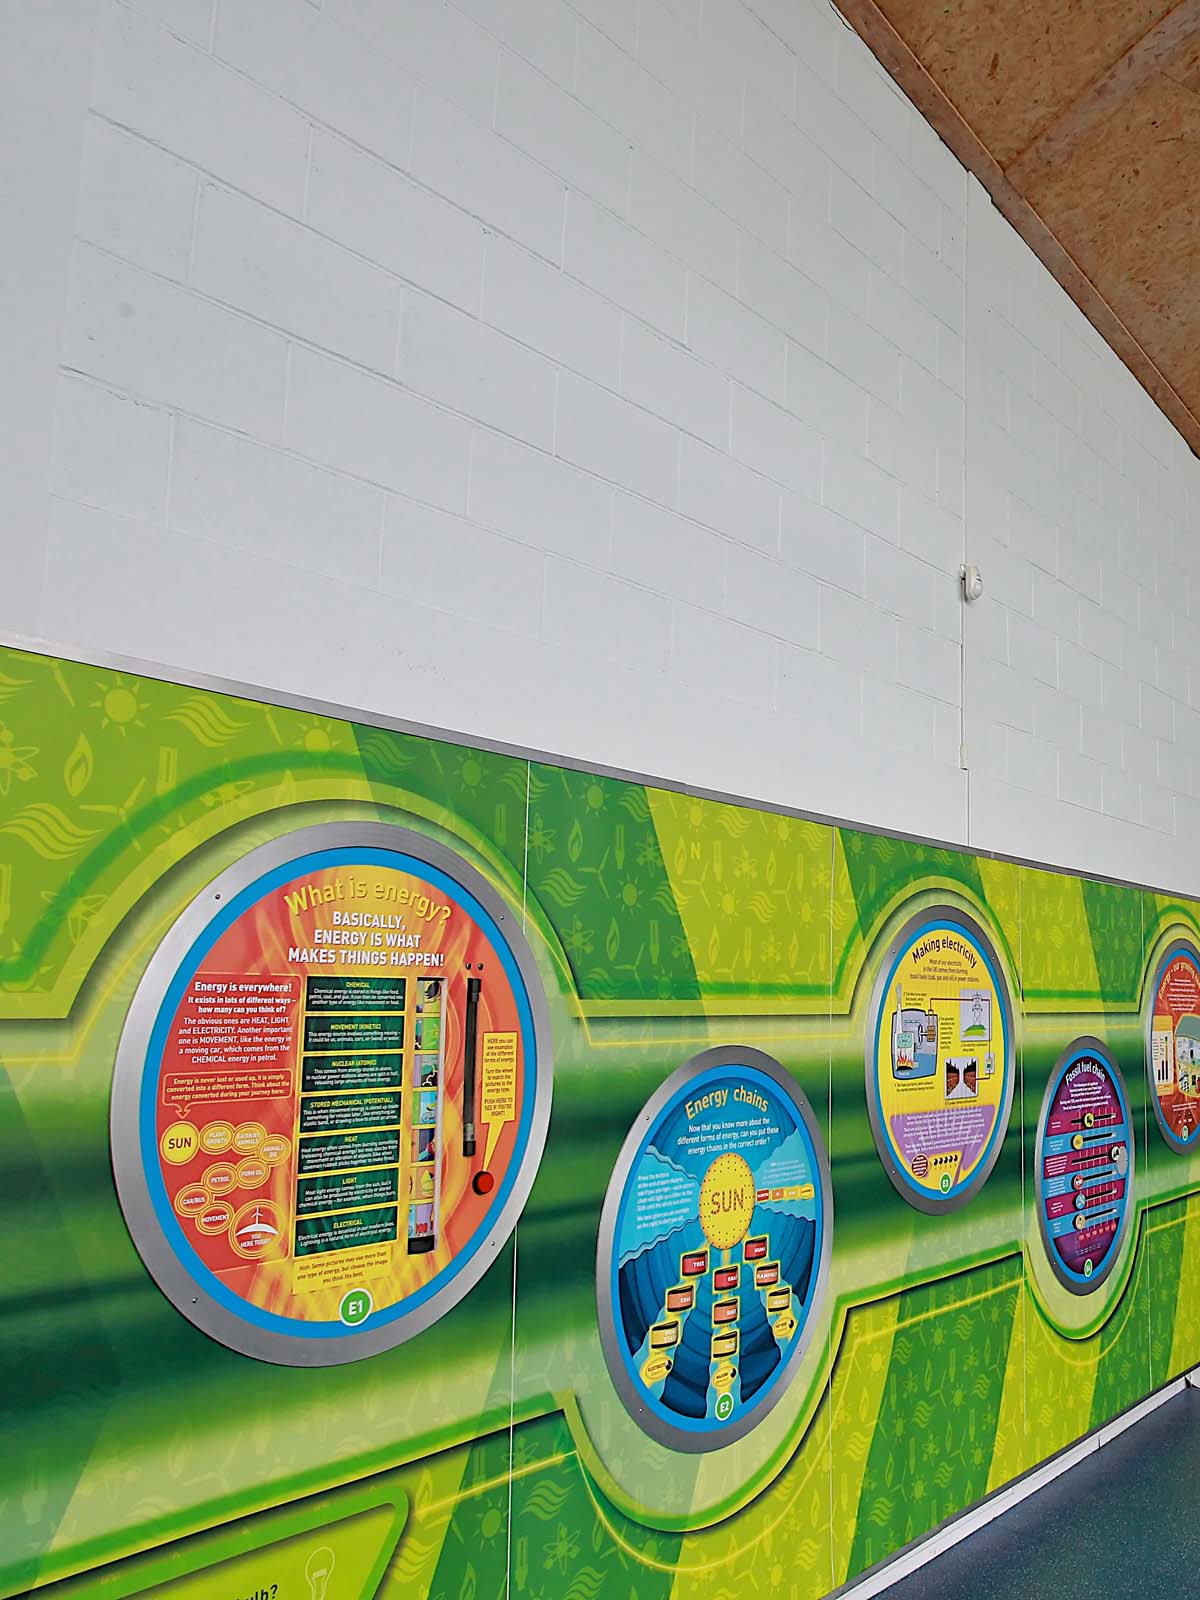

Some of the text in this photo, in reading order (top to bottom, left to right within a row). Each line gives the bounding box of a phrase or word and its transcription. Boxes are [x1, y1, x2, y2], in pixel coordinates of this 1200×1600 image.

[284, 876, 452, 926] What is energy?
[333, 912, 405, 931] BASICALLY,
[314, 929, 421, 948] ENERGY IS WHAT
[288, 948, 444, 967] MAKES THINGS HAPPEN!
[912, 936, 977, 968] Making electricity
[195, 982, 292, 993] Energy is everywhere!
[185, 1047, 208, 1055] moving
[192, 1056, 226, 1064] CHEMICAL
[1066, 1061, 1105, 1086] Fossil fuel chain
[332, 1099, 362, 1107] MECHANICAL
[685, 1085, 768, 1120] Energy chains
[712, 1123, 721, 1131] you
[168, 1138, 192, 1150] SUN
[677, 1136, 700, 1145] different
[688, 1147, 706, 1155] energy
[707, 1144, 722, 1152] chains
[738, 1140, 754, 1148] correct
[755, 1137, 770, 1146] order?
[711, 1188, 744, 1215] SUN
[201, 1214, 229, 1223] MOVEMENT
[333, 1219, 363, 1229] ELECTRICAL
[349, 1299, 363, 1316] E1
[720, 1401, 730, 1412] E2
